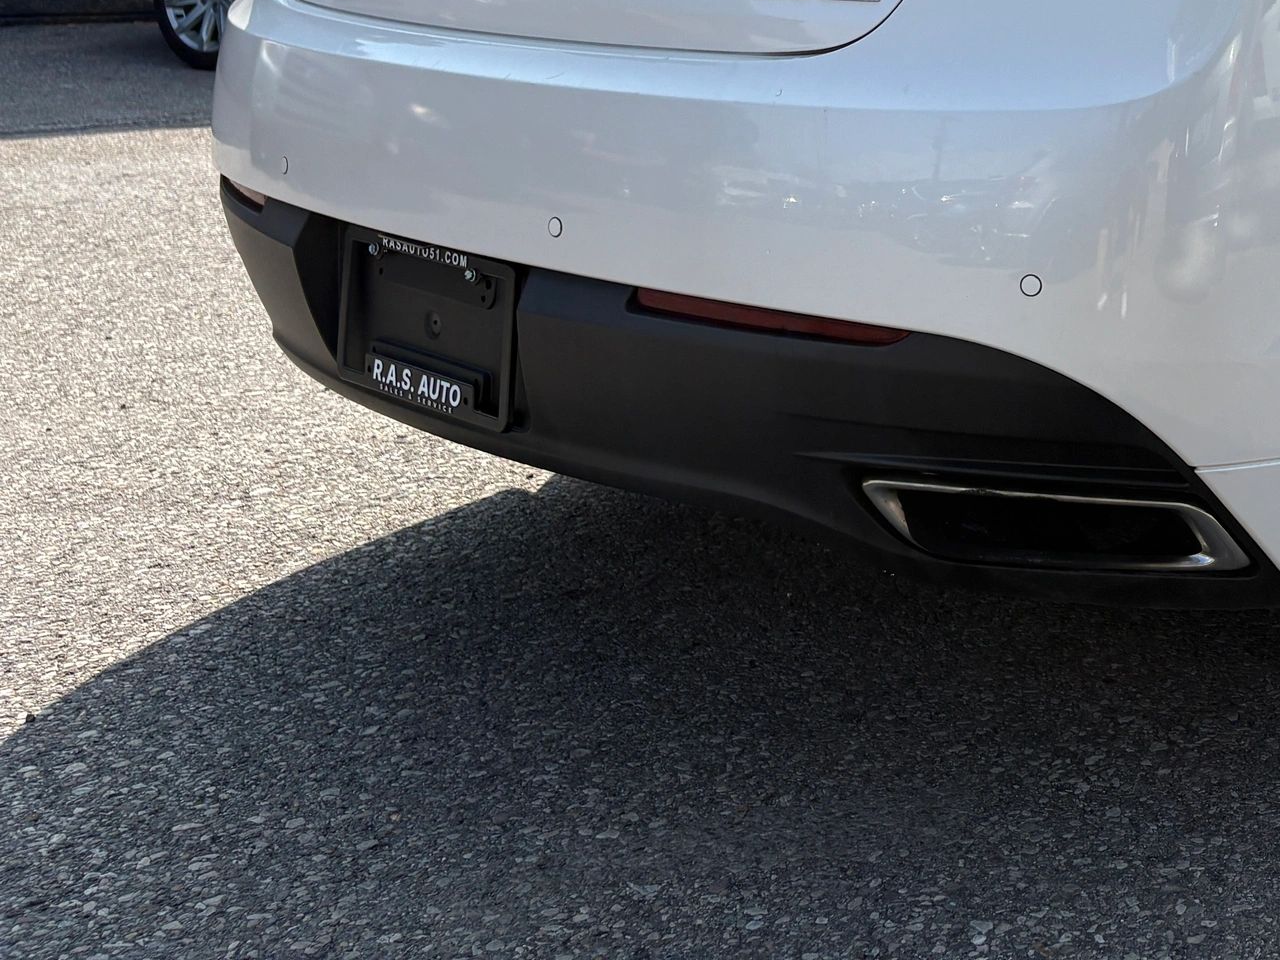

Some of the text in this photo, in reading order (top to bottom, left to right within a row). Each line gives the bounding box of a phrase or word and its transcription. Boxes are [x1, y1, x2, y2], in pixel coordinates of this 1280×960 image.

[382, 237, 467, 268] RASAUTO51.COM
[373, 358, 461, 407] R.A.S. AUTO
[379, 383, 403, 397] SALES
[417, 396, 453, 414] SERVICE
